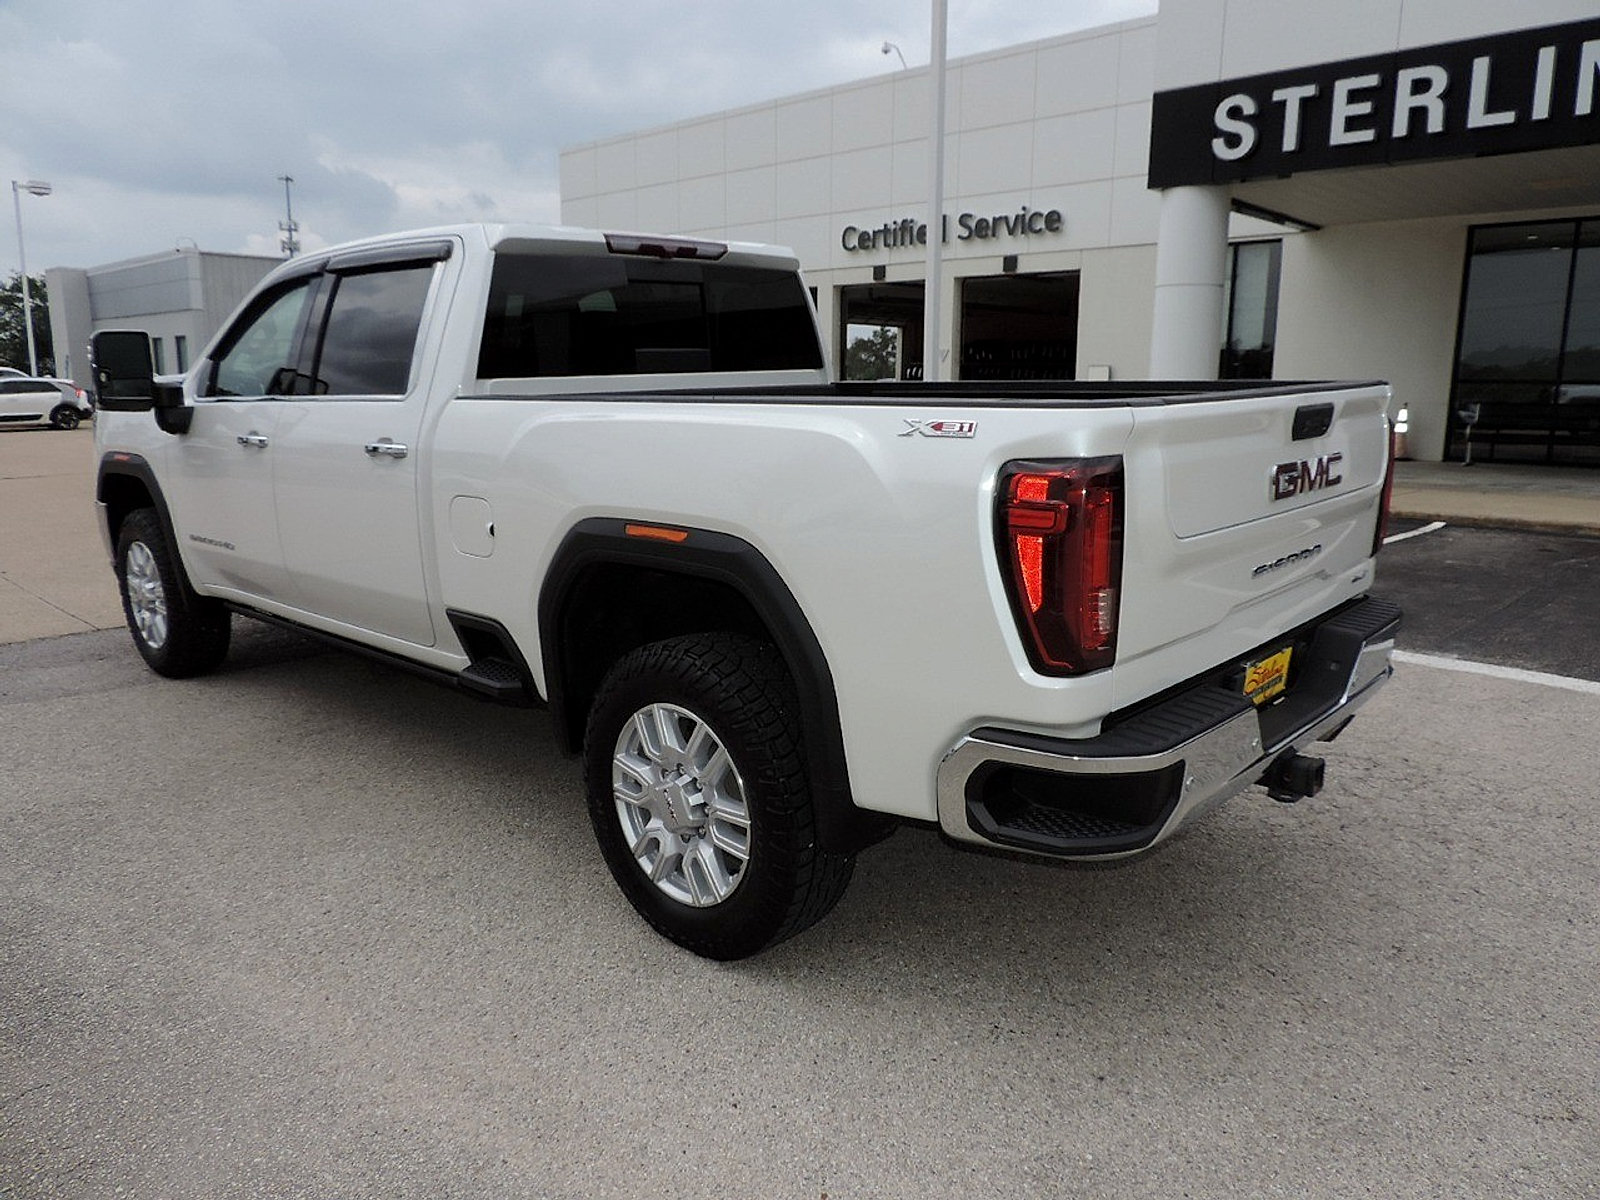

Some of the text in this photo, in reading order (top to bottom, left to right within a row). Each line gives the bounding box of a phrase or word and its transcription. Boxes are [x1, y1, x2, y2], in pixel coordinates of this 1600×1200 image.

[842, 205, 1062, 252] Certifie Service
[1271, 451, 1343, 501] GMC
